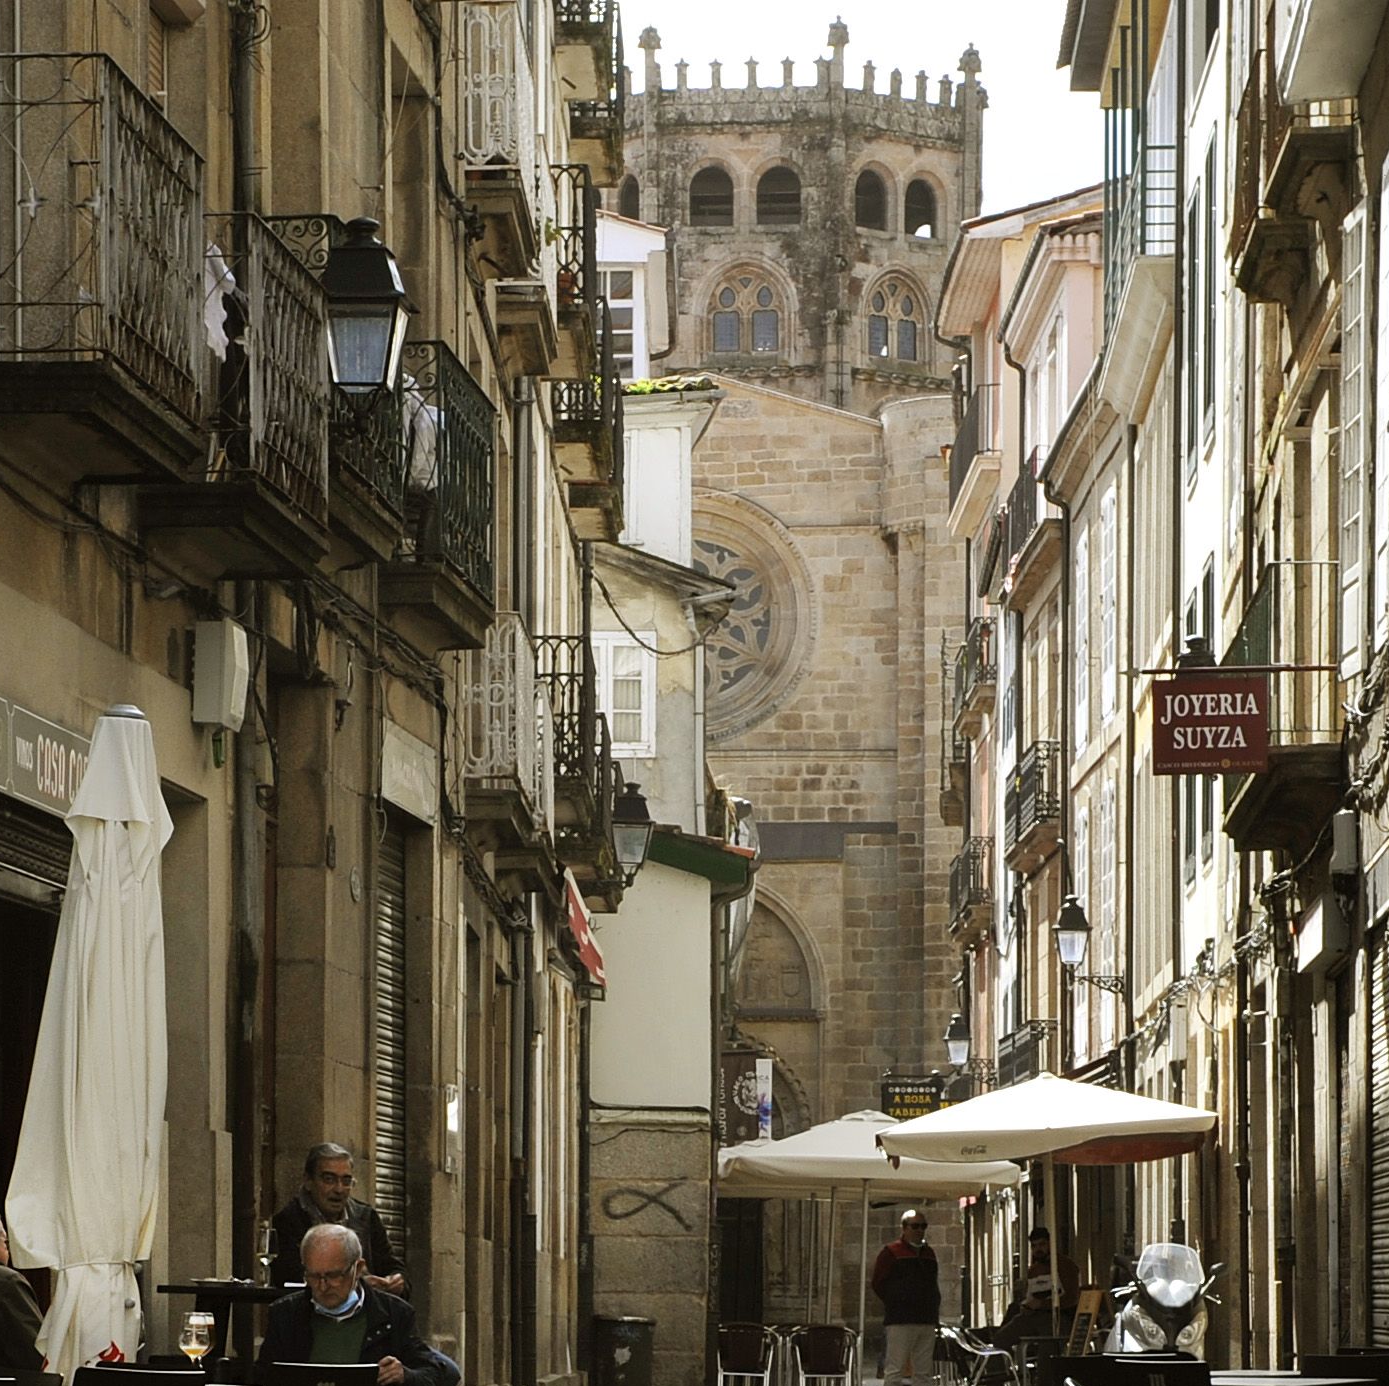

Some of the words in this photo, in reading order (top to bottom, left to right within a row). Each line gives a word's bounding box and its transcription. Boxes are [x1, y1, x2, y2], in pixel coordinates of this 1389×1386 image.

[1160, 692, 1260, 725] JOYERIA
[1173, 726, 1248, 750] SUYZA
[37, 733, 66, 800] CASA
